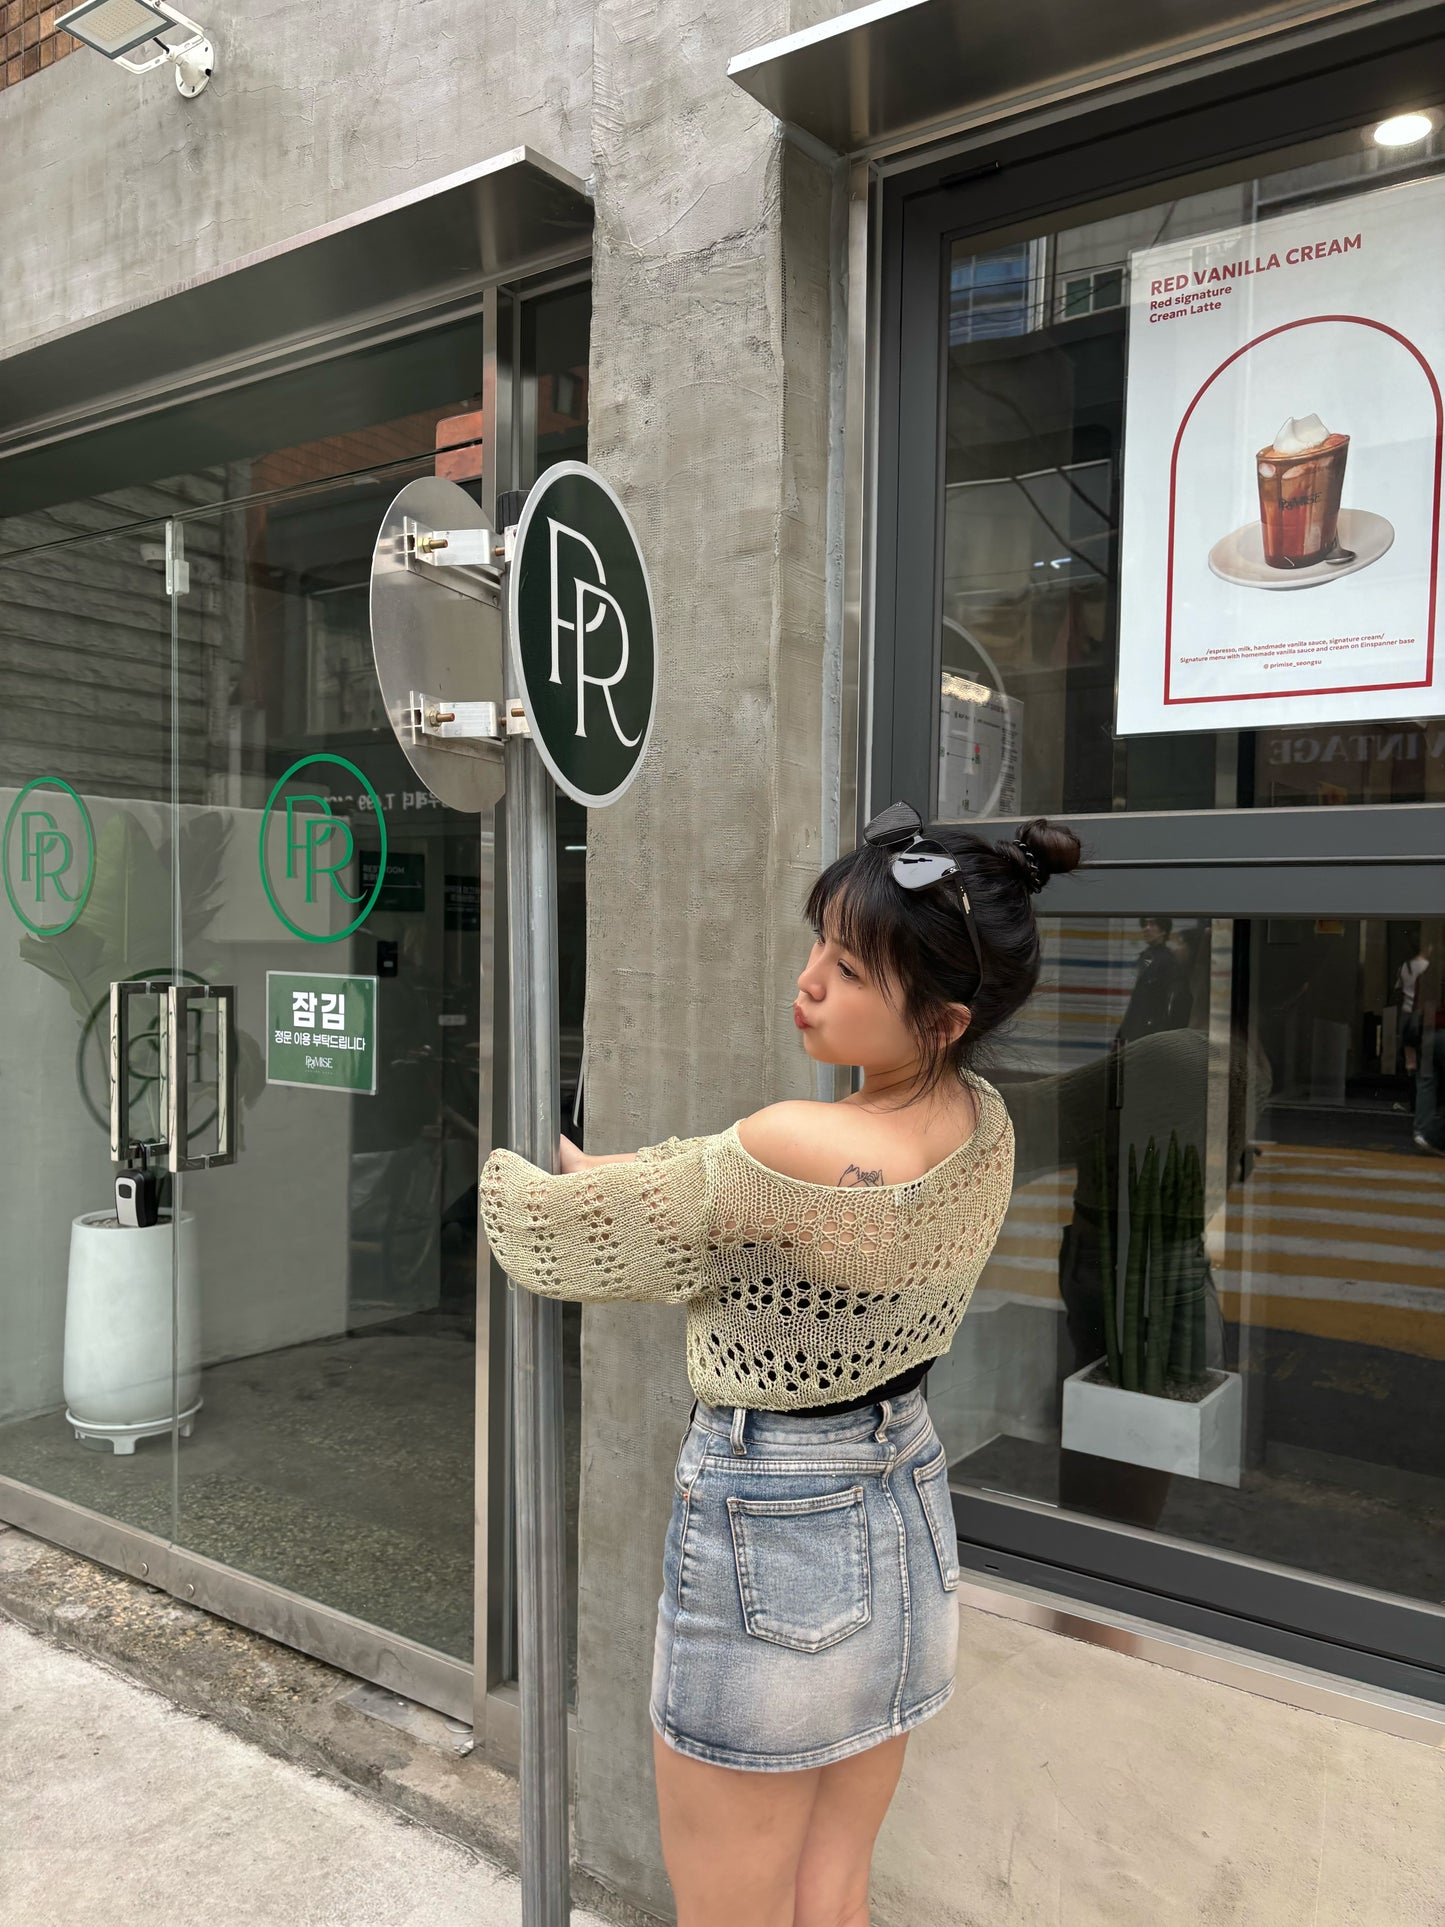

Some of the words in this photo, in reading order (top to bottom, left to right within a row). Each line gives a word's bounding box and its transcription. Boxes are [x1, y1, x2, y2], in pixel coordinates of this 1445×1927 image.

[1151, 274, 1190, 296] RED
[1193, 253, 1281, 286] VANILLA
[1285, 233, 1362, 265] CREAM
[1150, 296, 1172, 310] Red
[1175, 285, 1232, 305] signature
[1149, 307, 1187, 323] Cream
[1190, 300, 1222, 315] Latte
[1360, 640, 1398, 648] Einspanner
[292, 991, 345, 1030] 잠김
[275, 1030, 292, 1045] 정문
[293, 1032, 311, 1046] 이용
[312, 1034, 366, 1051] 부탁드립니다
